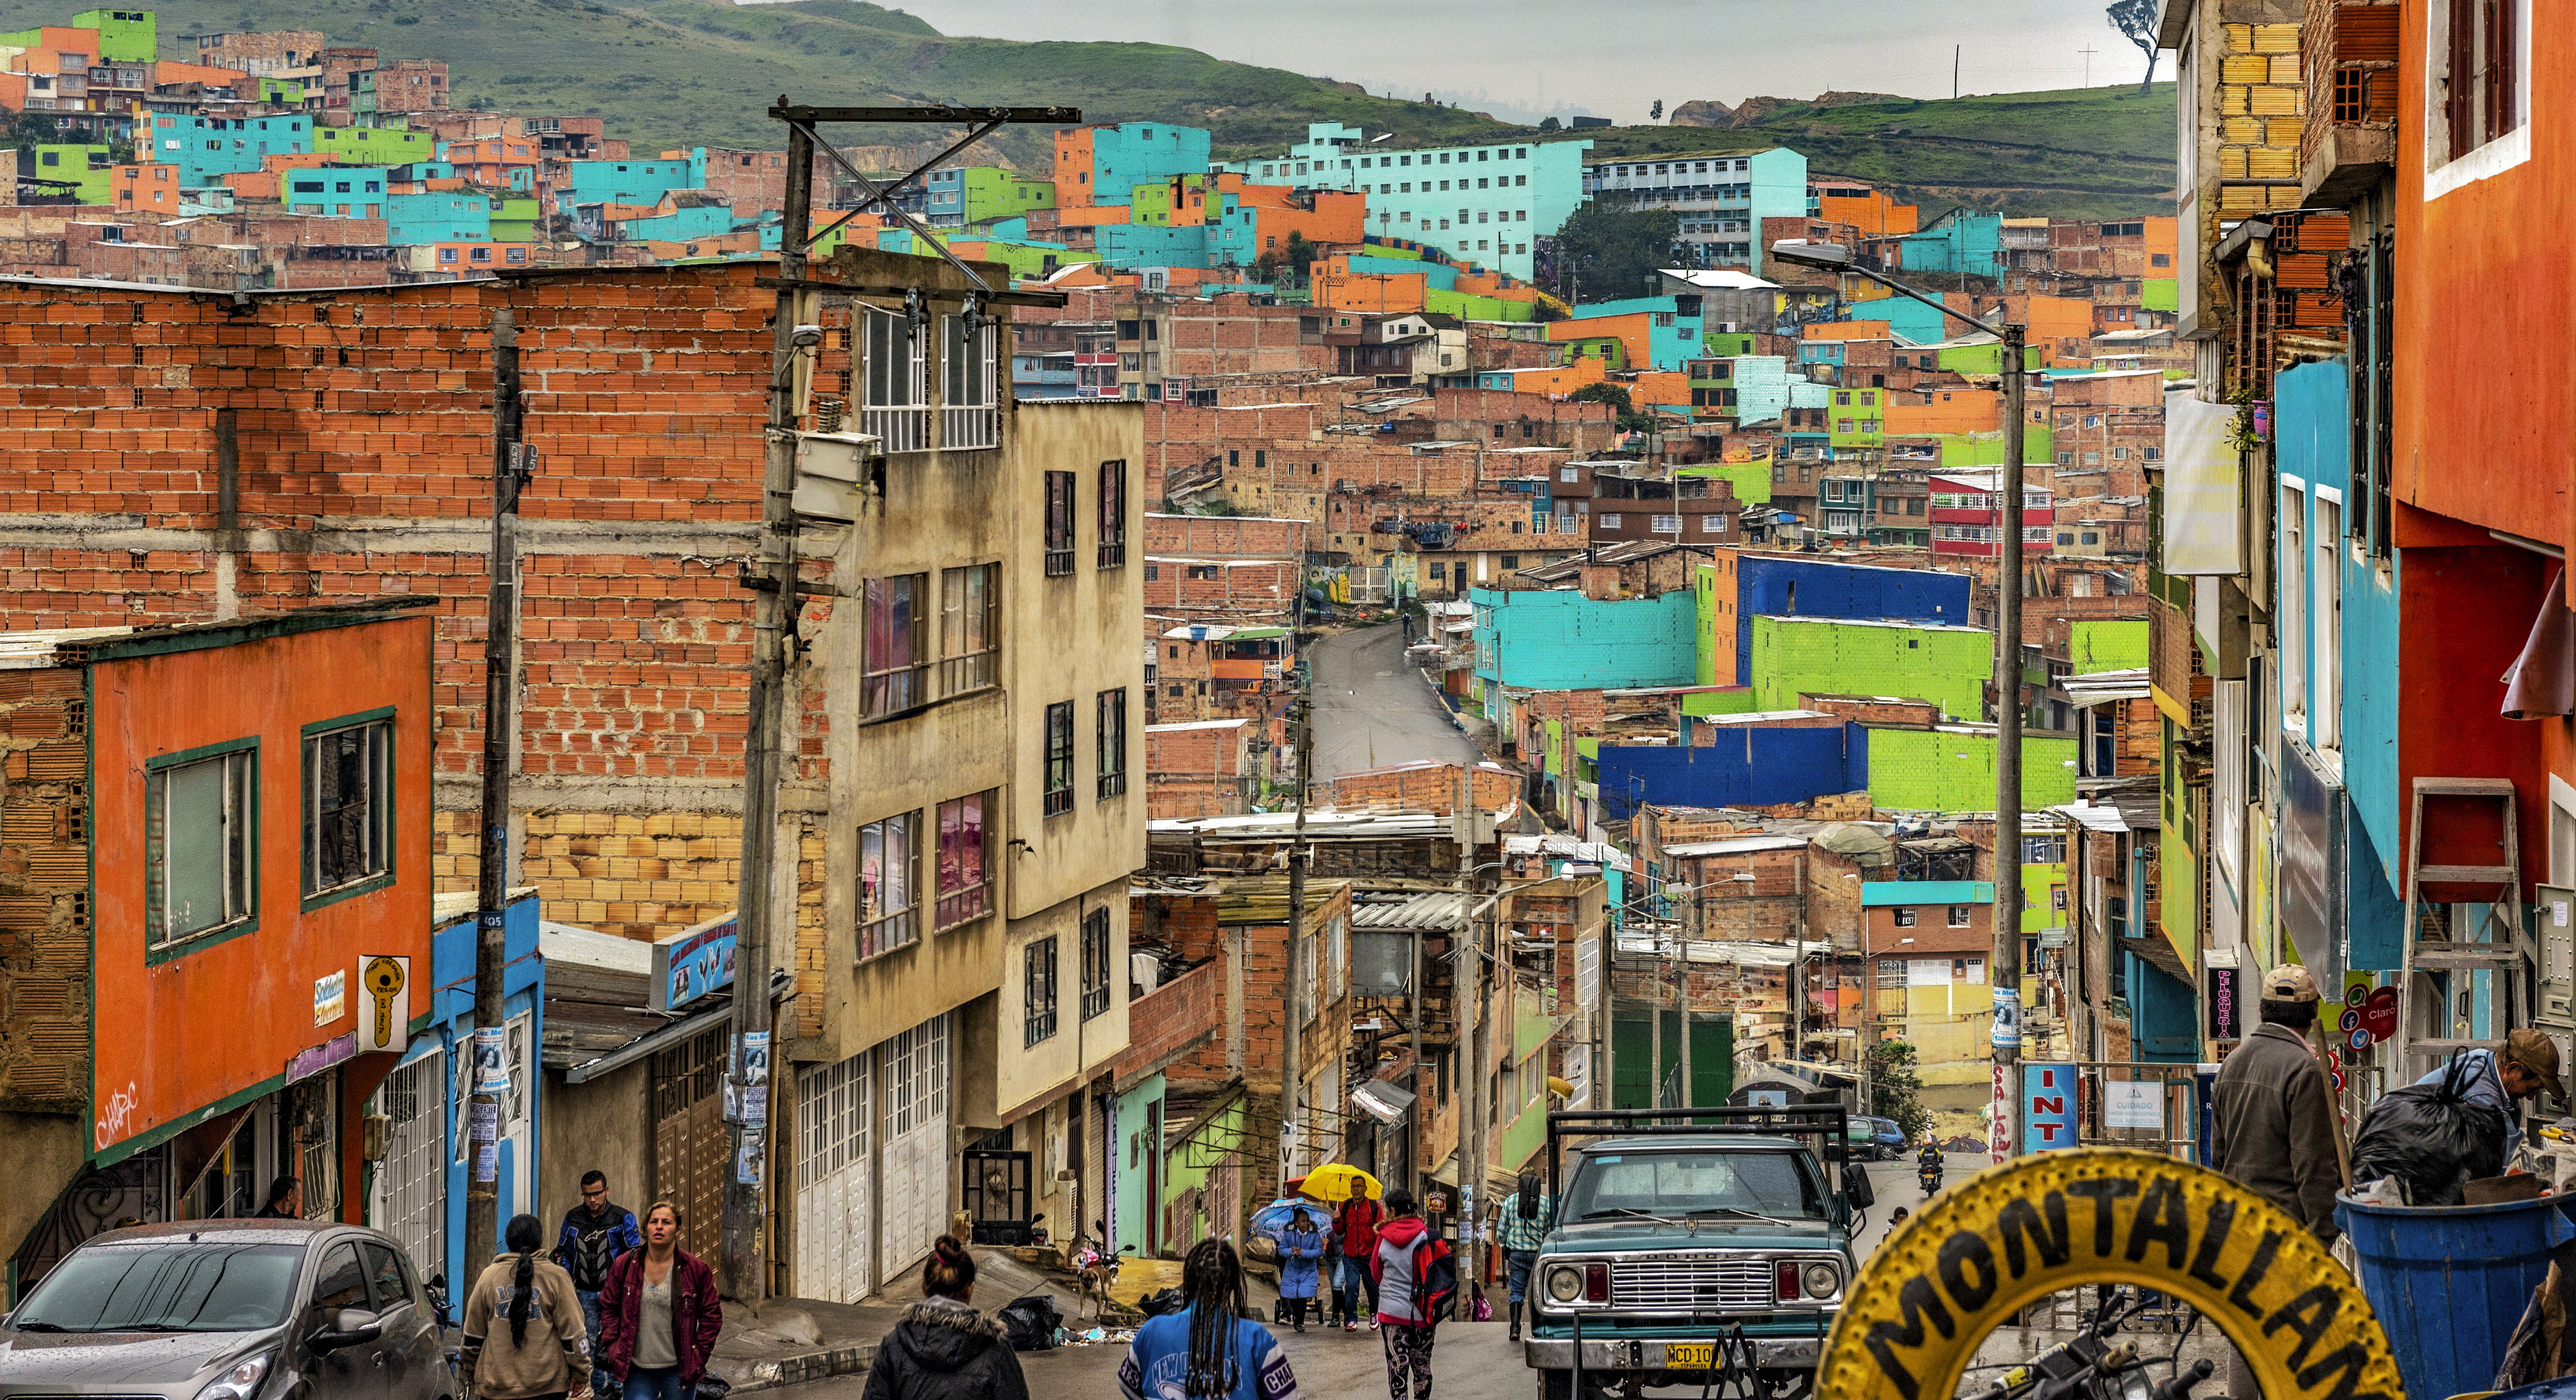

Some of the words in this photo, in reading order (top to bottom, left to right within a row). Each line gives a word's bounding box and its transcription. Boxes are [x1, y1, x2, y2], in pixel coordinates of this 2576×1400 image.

[2218, 971, 2231, 1038] PELUQUERIA
[473, 1105, 495, 1113] URGENTE
[2033, 1069, 2063, 1154] INT
